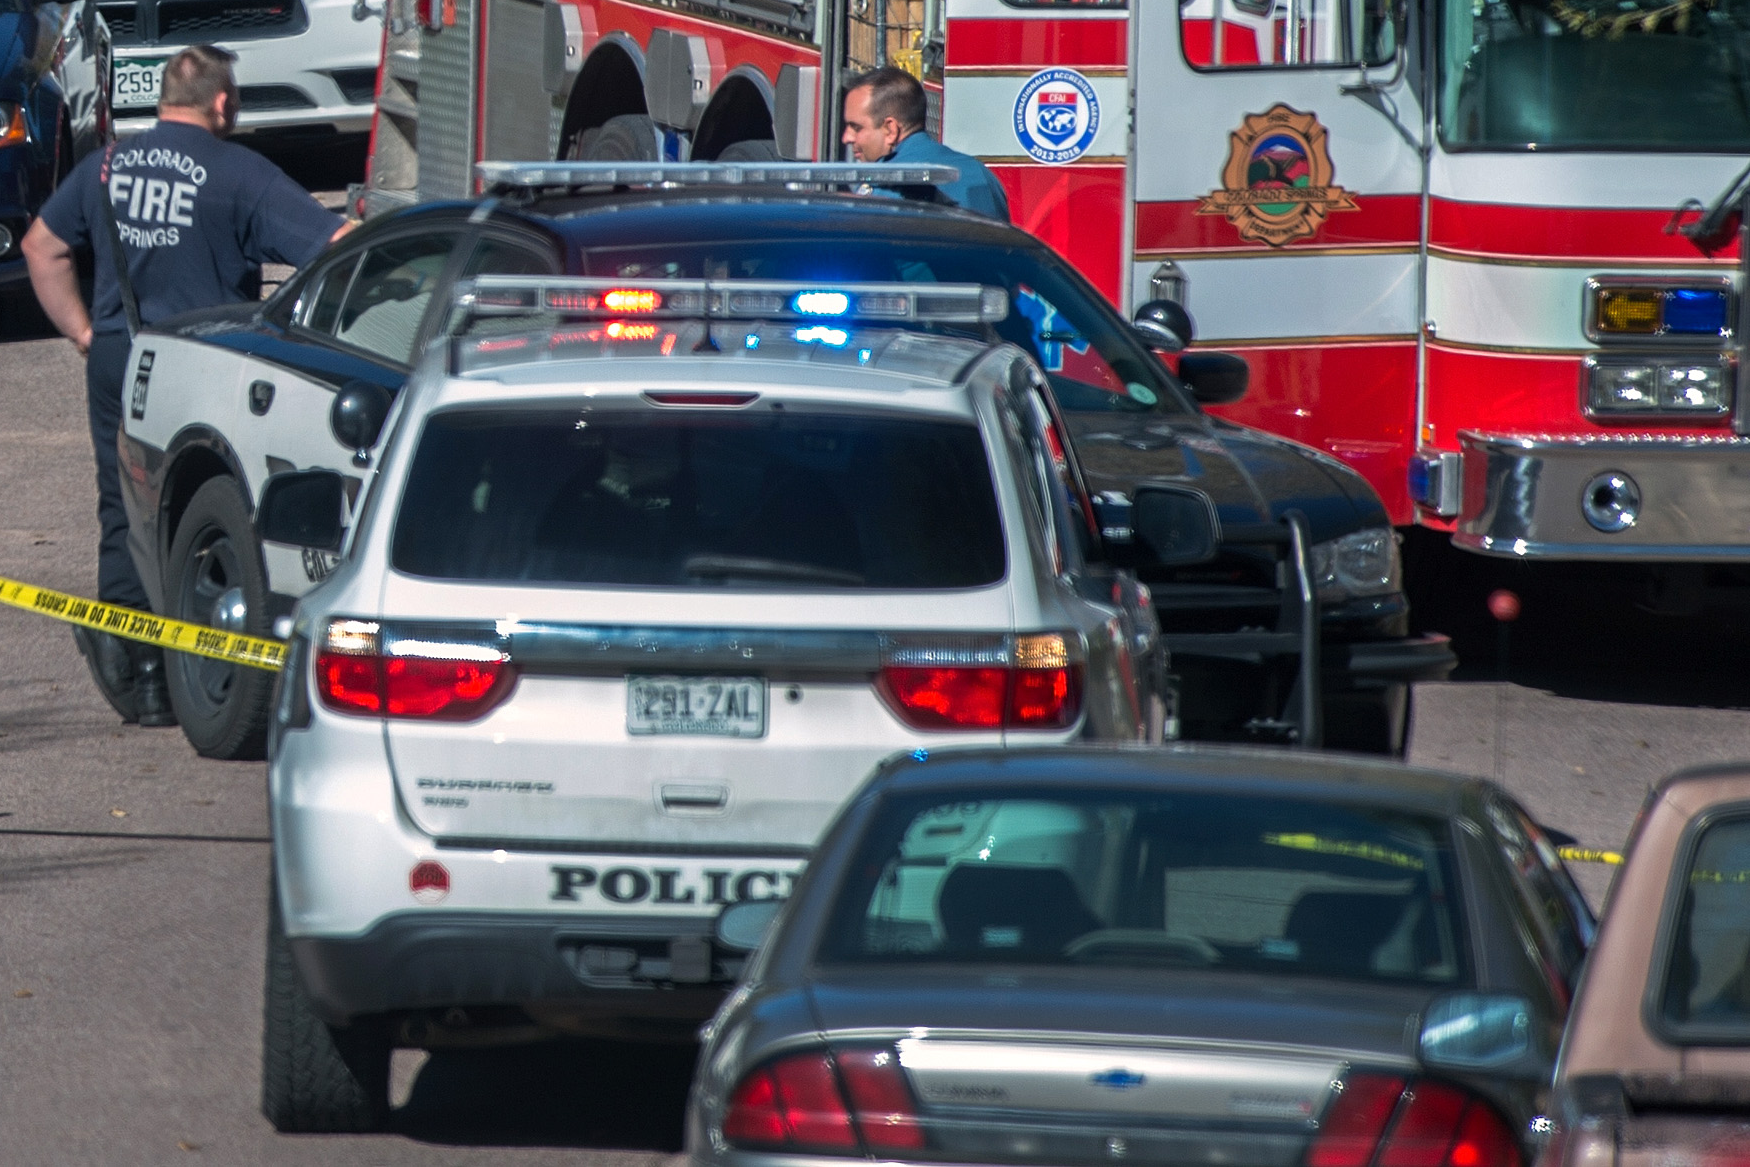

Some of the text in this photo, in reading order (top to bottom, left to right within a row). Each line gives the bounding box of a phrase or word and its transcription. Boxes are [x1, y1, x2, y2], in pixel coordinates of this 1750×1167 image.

[1017, 73, 1051, 133] INTERNATIONALLY
[1054, 72, 1094, 100] ACCREDITED
[1048, 94, 1066, 103] CFAI
[111, 148, 207, 186] COLORADO
[109, 173, 198, 227] FIRE
[116, 220, 180, 248] PRINGS
[34, 592, 166, 641] POLICE LINE DO NOT CROSS
[550, 864, 803, 903] POLIC
